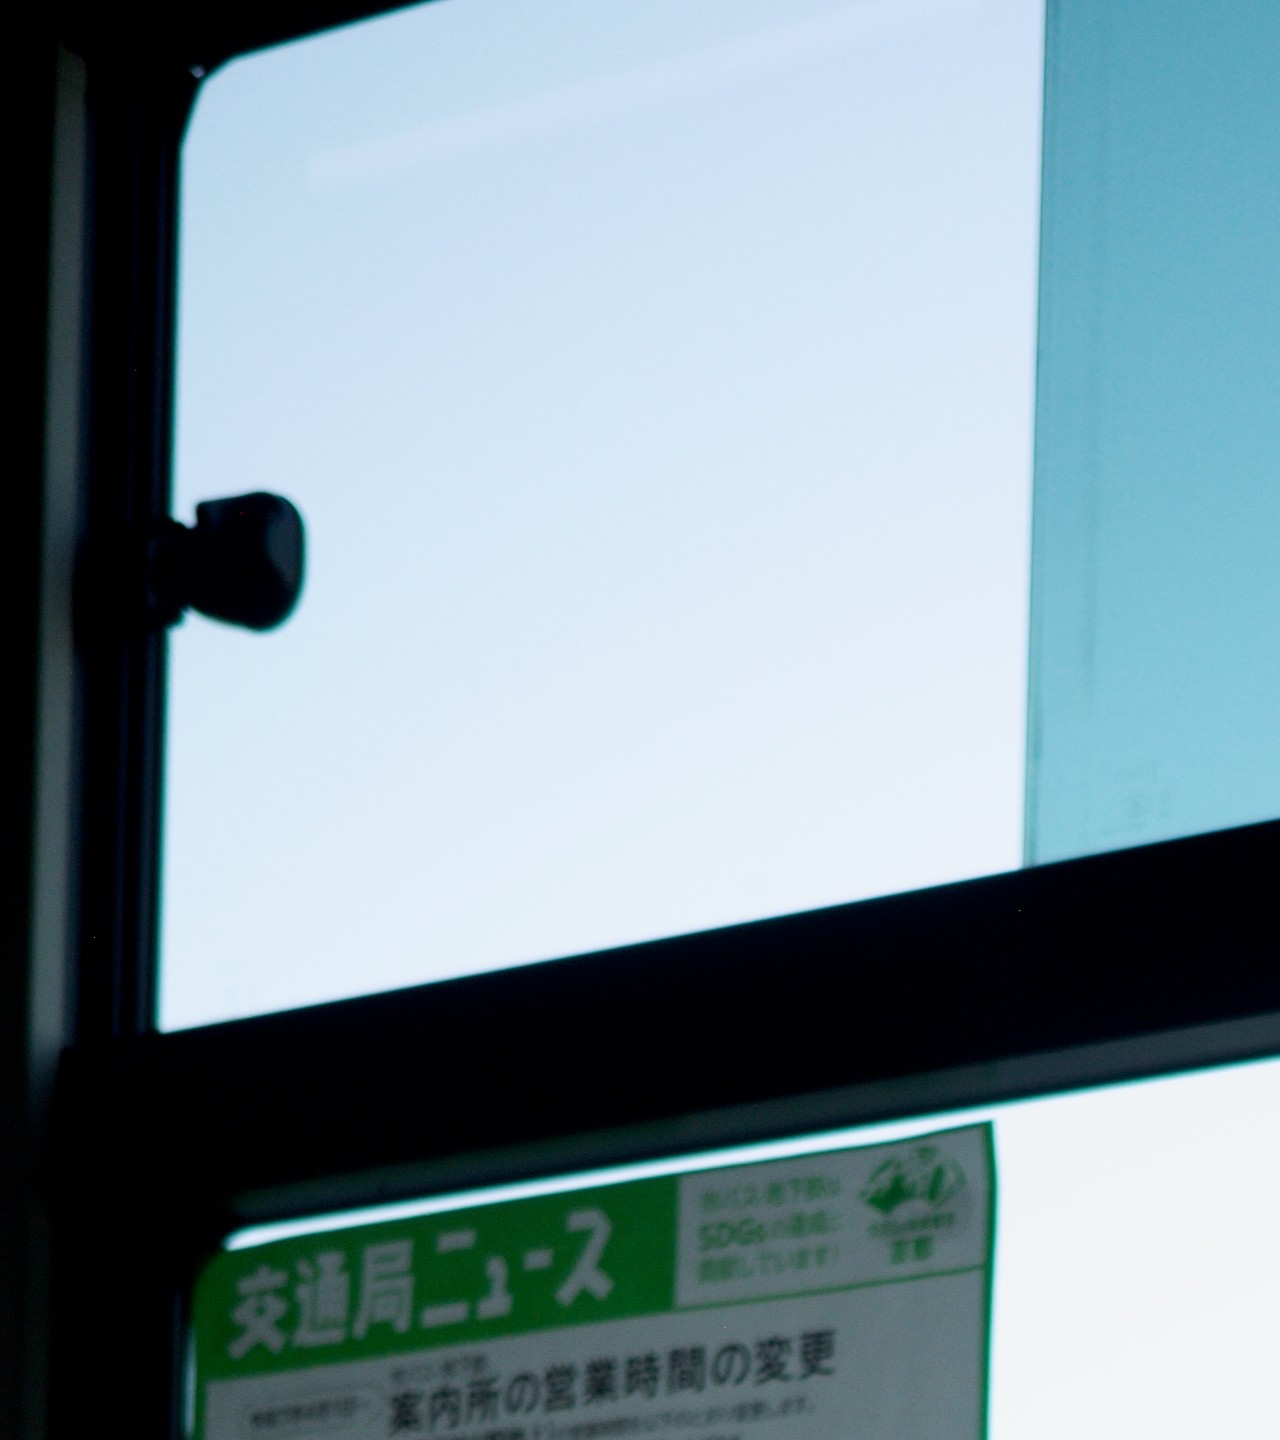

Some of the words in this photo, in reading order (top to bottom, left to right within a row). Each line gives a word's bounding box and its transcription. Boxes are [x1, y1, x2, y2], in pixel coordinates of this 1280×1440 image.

[227, 1206, 615, 1360] 交通局ニュース
[387, 1328, 837, 1438] 案内所の営業時間の変更
